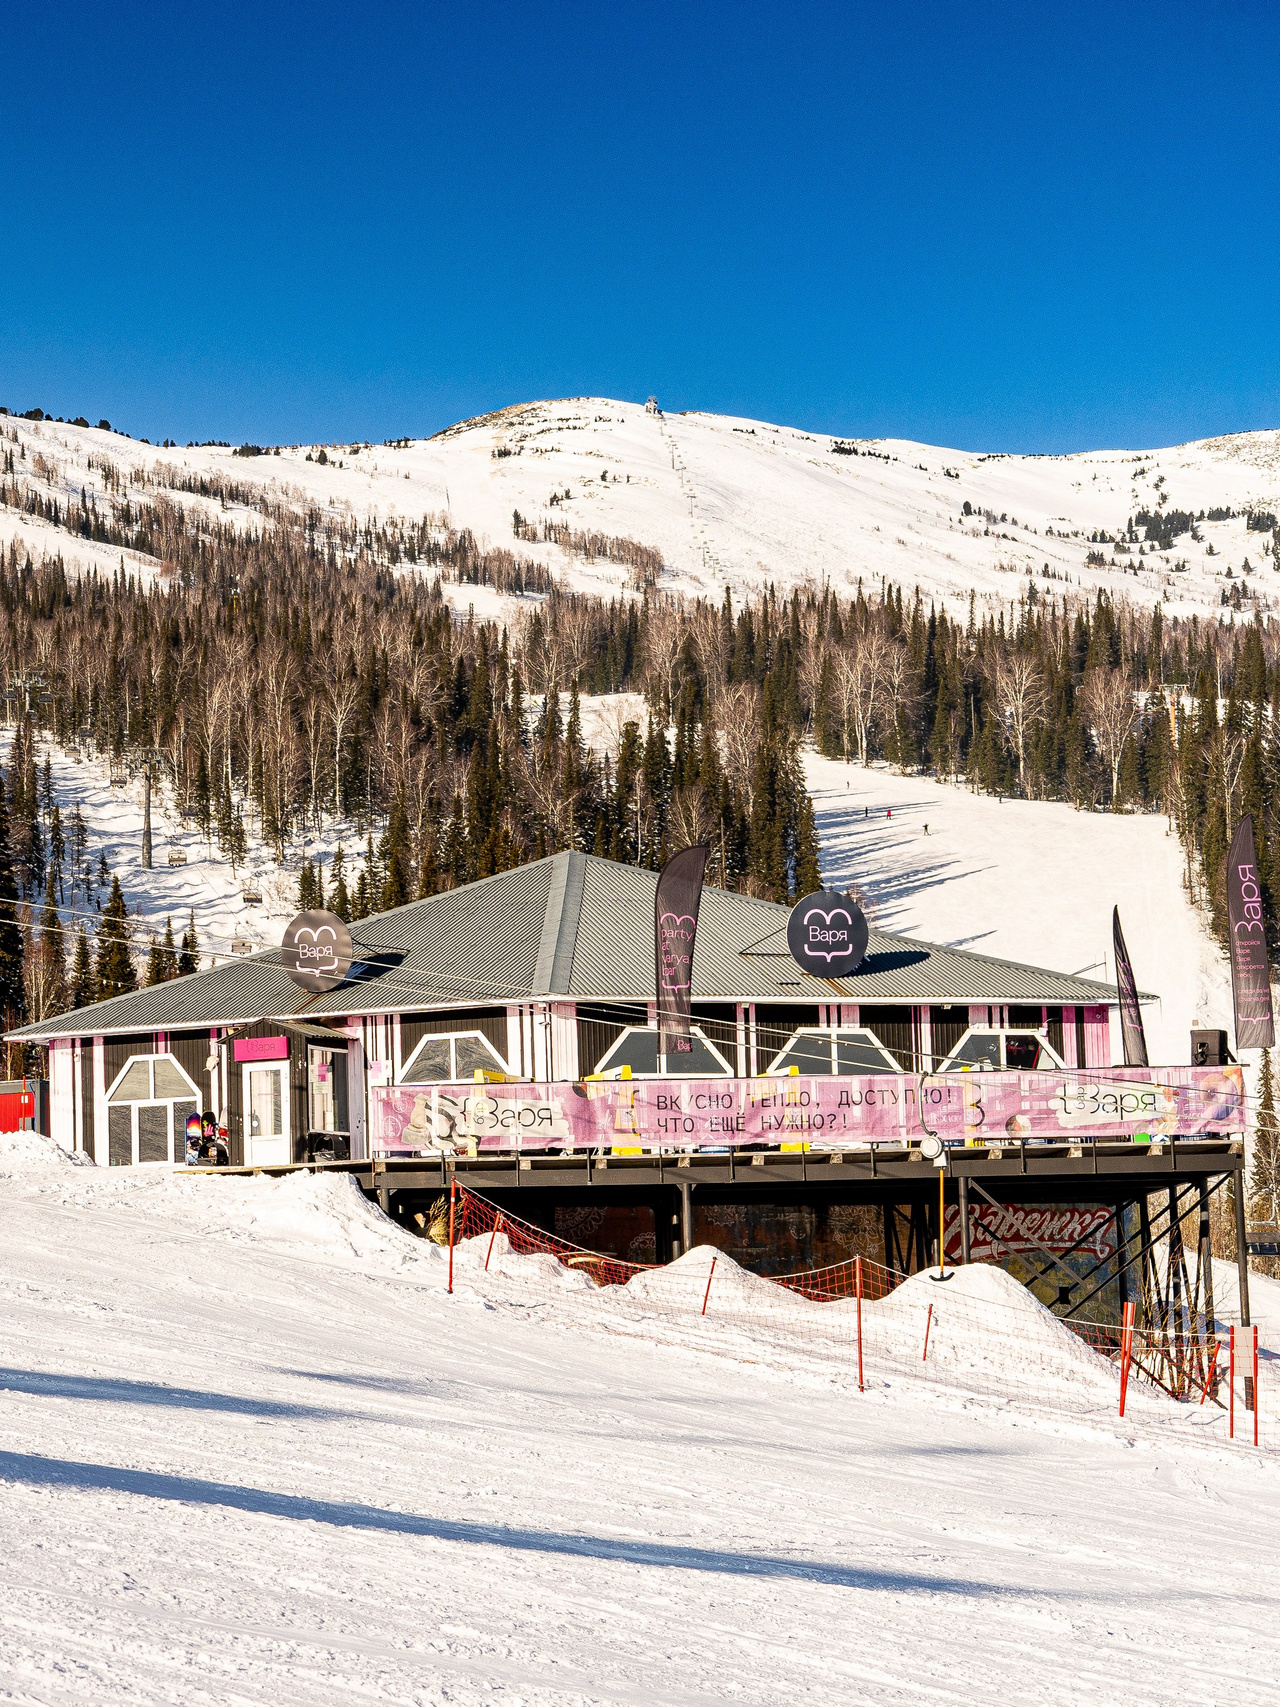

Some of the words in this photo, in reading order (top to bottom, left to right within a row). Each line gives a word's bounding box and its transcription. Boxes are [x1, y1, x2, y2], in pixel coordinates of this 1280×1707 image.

[661, 929, 693, 942] party
[808, 925, 848, 946] Варя
[661, 940, 671, 950] at
[299, 943, 333, 961] Варя
[661, 954, 690, 966] varya
[662, 964, 676, 976] bar
[657, 1117, 695, 1133] ЧТО
[709, 1112, 746, 1134] ЕЩЁ
[761, 1113, 847, 1131] НУЖНО?!
